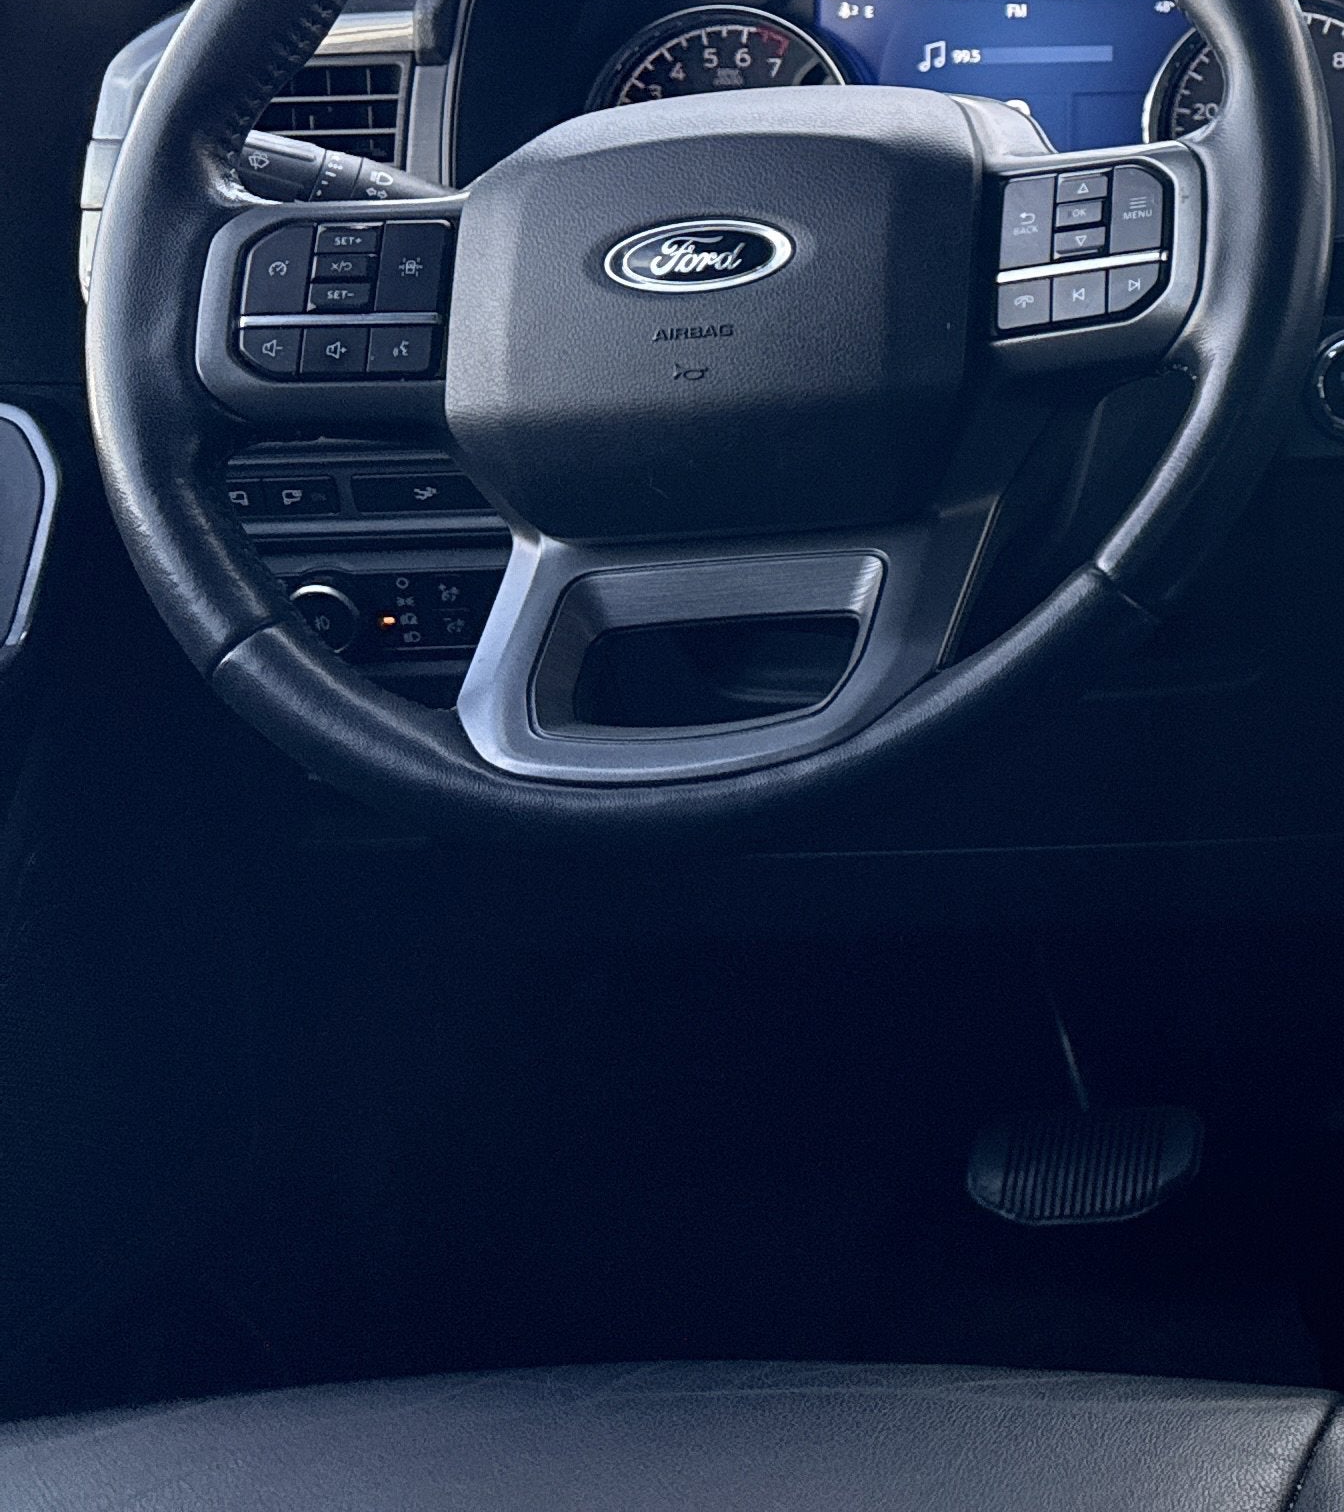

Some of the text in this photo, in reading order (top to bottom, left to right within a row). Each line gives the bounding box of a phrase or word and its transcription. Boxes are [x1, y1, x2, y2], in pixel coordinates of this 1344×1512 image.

[1005, 3, 1027, 19] FM
[703, 48, 719, 68] 5
[735, 48, 751, 67] 6
[669, 62, 687, 81] 4
[767, 58, 783, 78] 7
[1193, 103, 1219, 121] 20
[1072, 208, 1087, 218] OK
[1123, 209, 1153, 220] MENU
[1013, 225, 1039, 236] BACK
[650, 235, 747, 276] Ford
[652, 324, 735, 342] AIRBAG
